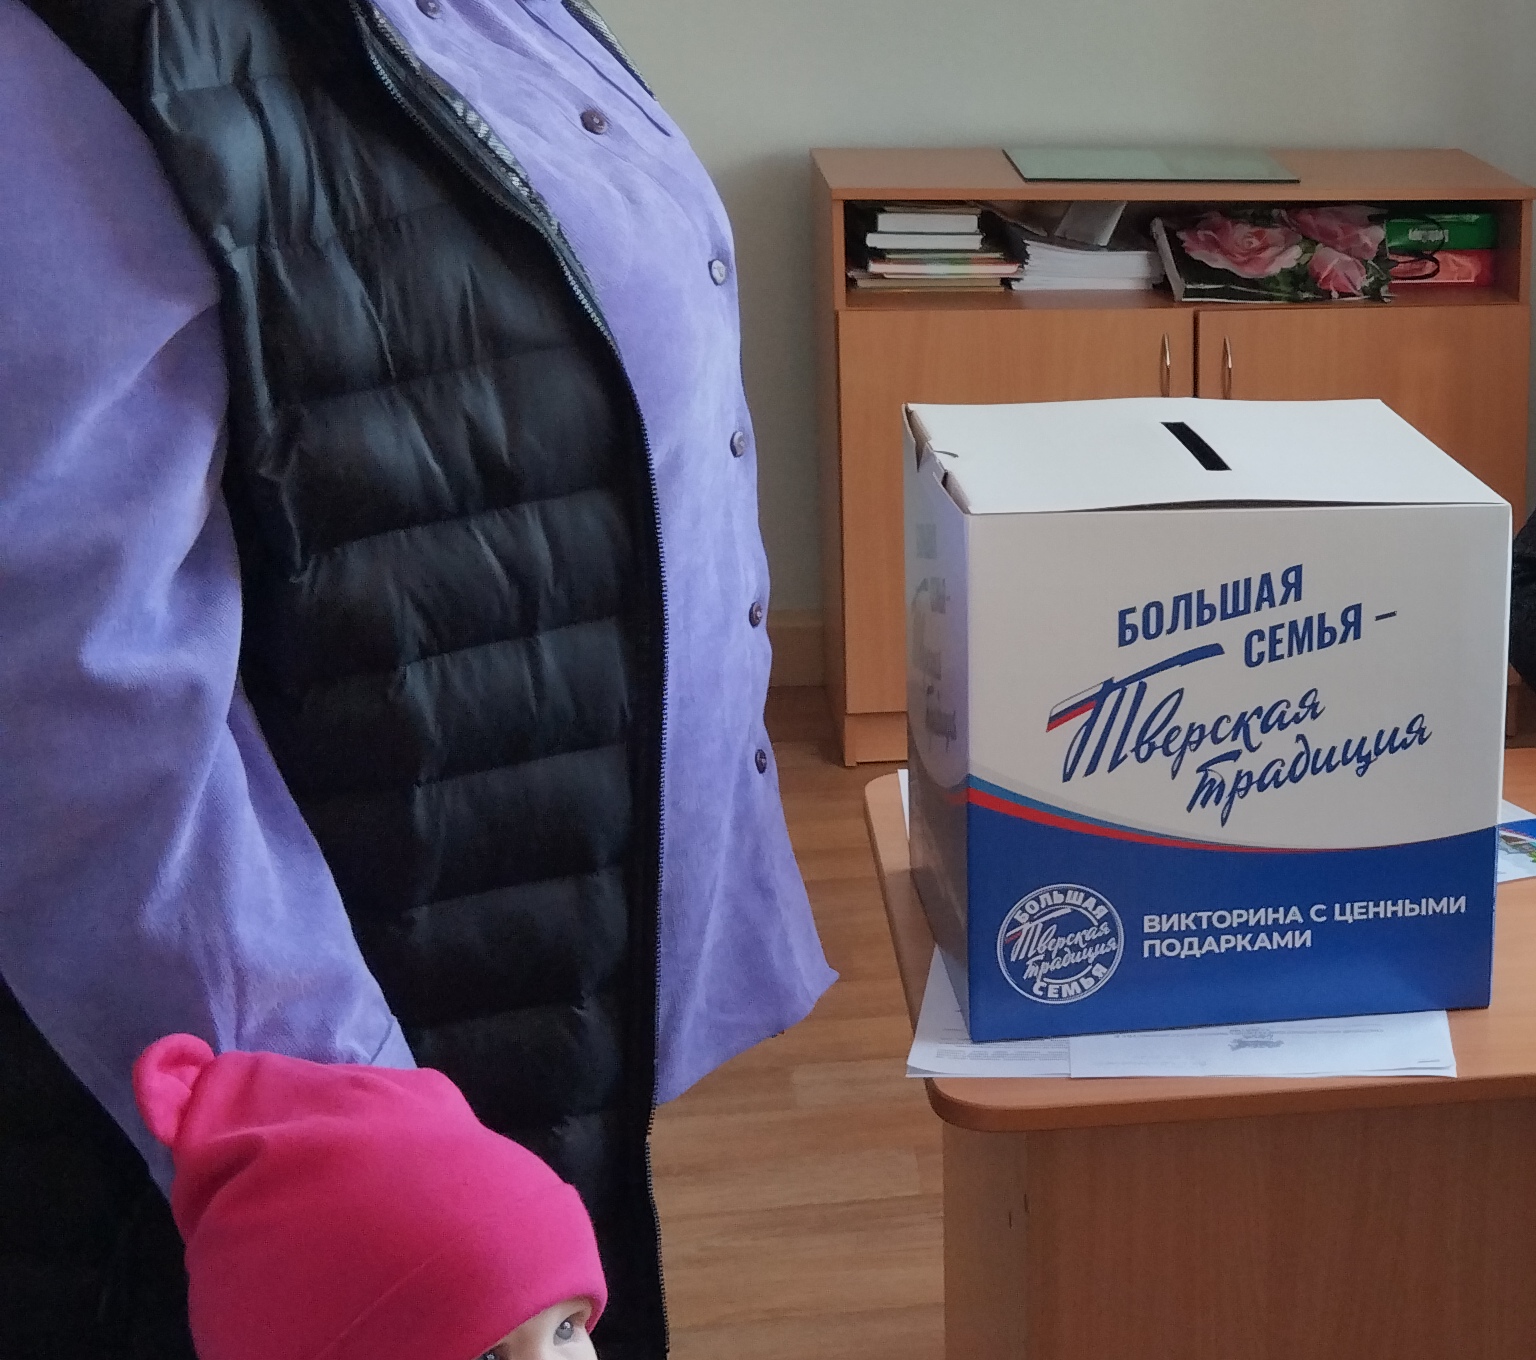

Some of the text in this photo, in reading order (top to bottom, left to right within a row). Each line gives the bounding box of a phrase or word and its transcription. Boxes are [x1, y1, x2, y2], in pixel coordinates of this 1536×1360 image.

[1117, 564, 1303, 647] БОЛЬШАЯ
[1243, 603, 1363, 669] СЕМЬЯ
[1046, 642, 1326, 783] Тверская
[1186, 712, 1433, 827] традиция
[1014, 890, 1109, 923] БОЛЬШАЯ
[1143, 895, 1467, 934] ВИКТОРИНА С ЦЕННЫМИ
[1005, 907, 1111, 962] Тверская
[1023, 937, 1118, 982] традиция
[1143, 929, 1312, 959] ПОДАРКАМИ
[1032, 962, 1108, 998] СЕМЬЯ
